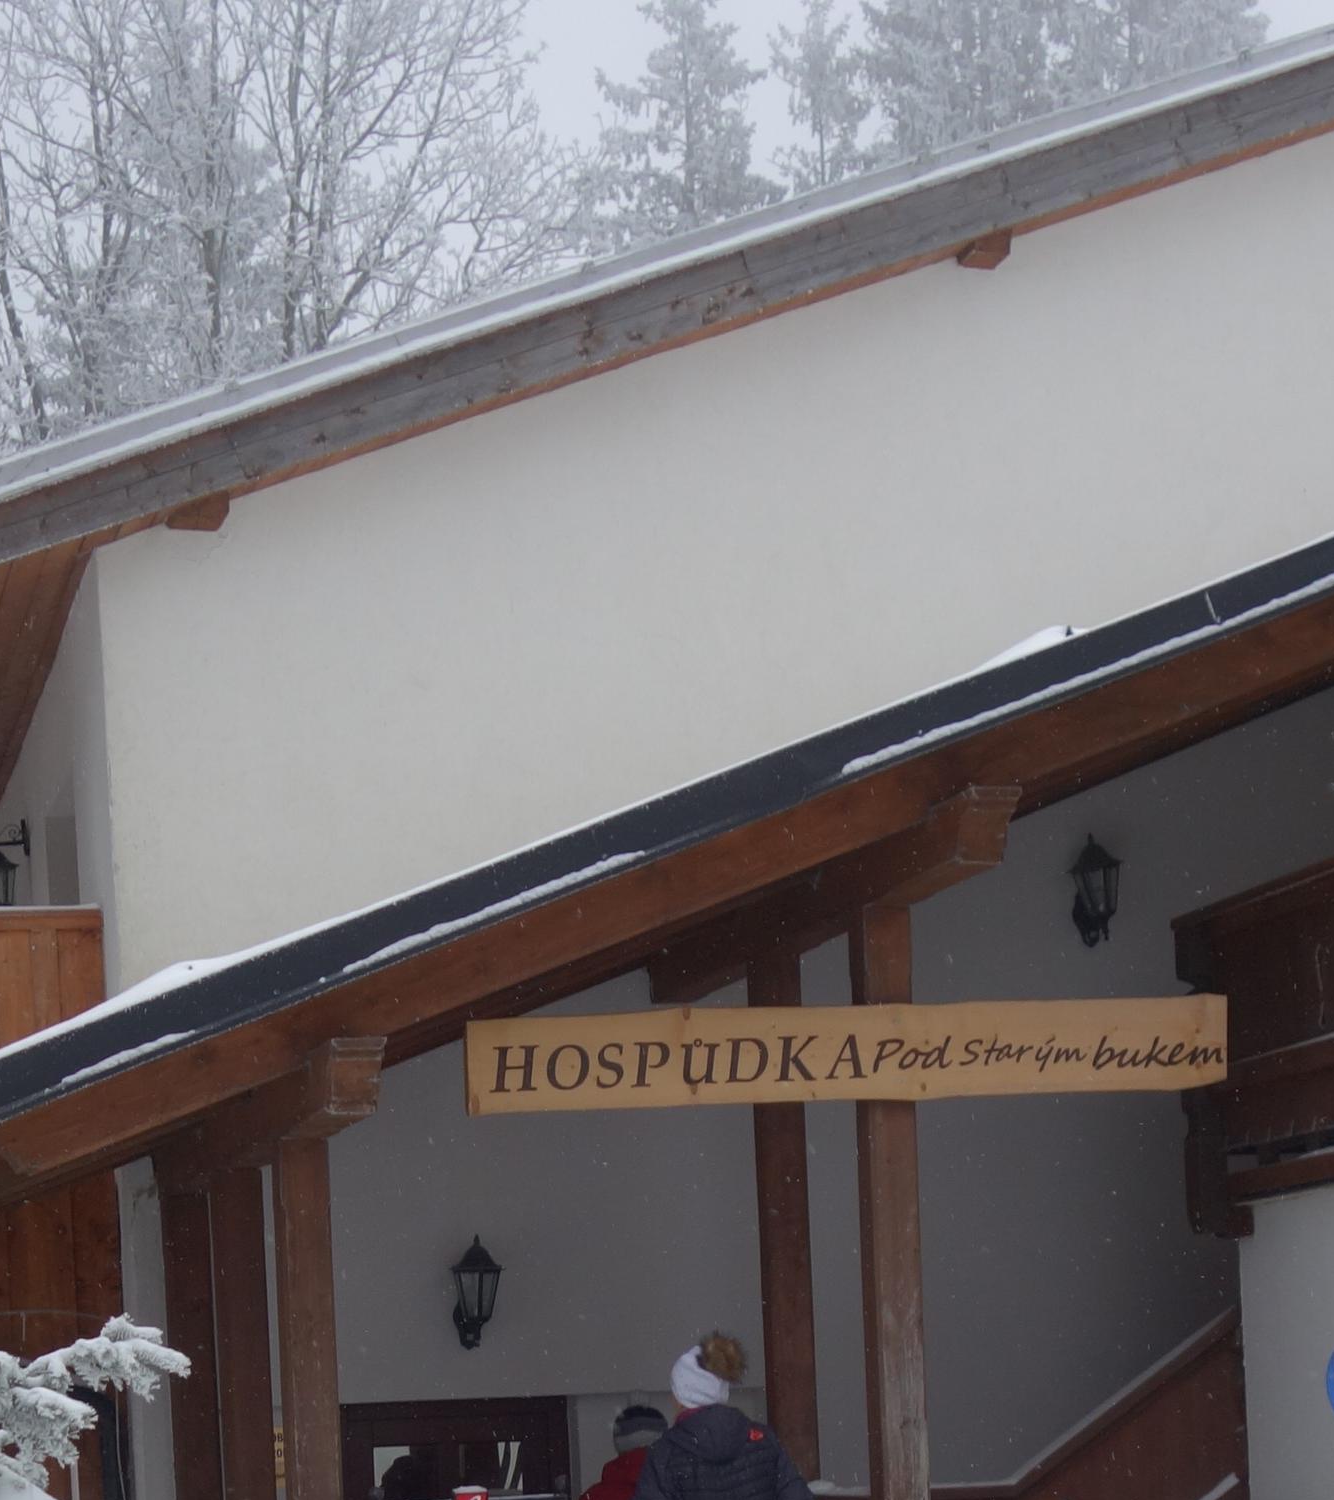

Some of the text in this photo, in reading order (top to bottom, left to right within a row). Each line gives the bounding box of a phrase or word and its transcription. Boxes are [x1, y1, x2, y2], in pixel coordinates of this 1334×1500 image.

[872, 1035, 953, 1073] Pod
[959, 1035, 1086, 1073] Starým
[1092, 1035, 1223, 1071] bukem
